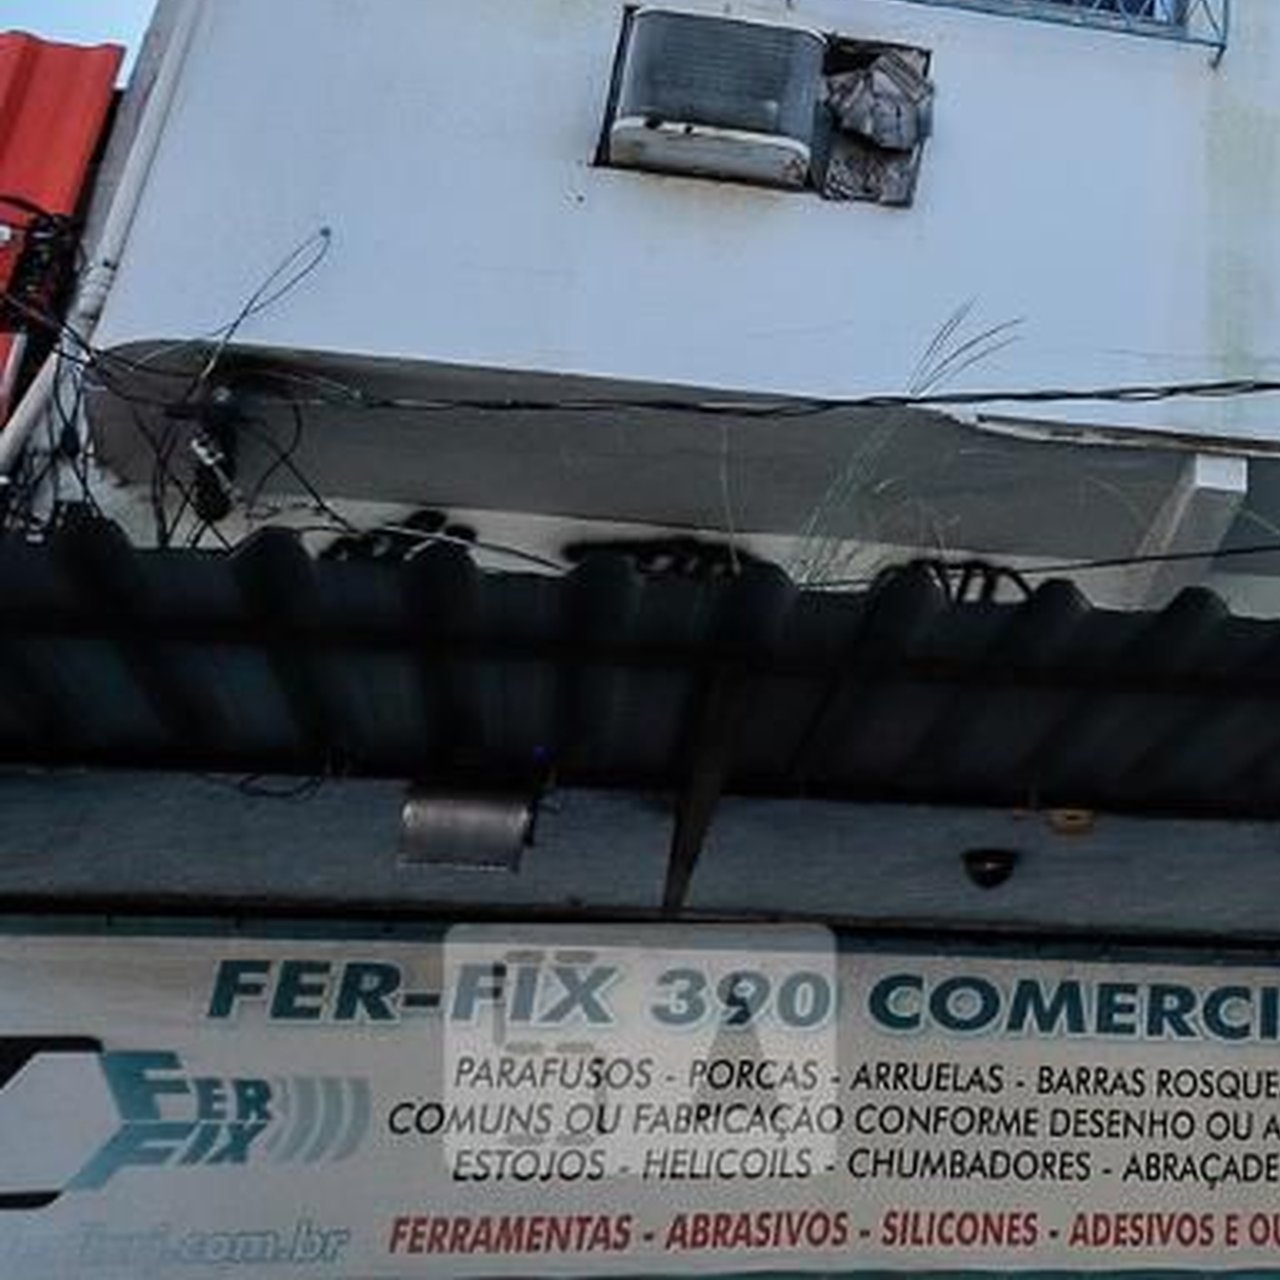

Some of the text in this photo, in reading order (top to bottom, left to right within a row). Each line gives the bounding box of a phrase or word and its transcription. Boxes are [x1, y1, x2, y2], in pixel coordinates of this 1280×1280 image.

[206, 957, 630, 1028] FER-FIX
[648, 967, 838, 1031] 390
[454, 1056, 653, 1093] PARAFUSOS
[689, 1057, 820, 1093] PORCAS
[850, 1059, 1003, 1095] ARRUELAS
[1036, 1064, 1147, 1097] BARRAS
[388, 1101, 554, 1137] COMUNS
[564, 1101, 624, 1137] OU
[853, 1105, 1041, 1138] CONFORME
[1048, 1107, 1198, 1141] DESENHO
[1204, 1109, 1256, 1141] OU
[451, 1147, 606, 1183] ESTOJOS
[642, 1146, 812, 1181] HELICOILS
[847, 1150, 1092, 1183] CHUMBADORES
[389, 1214, 633, 1254] FERRAMENTAS
[665, 1212, 850, 1250] ABRASIVOS
[881, 1211, 1039, 1249] SILICONES
[1068, 1213, 1220, 1248] ADESIVOS
[1225, 1213, 1238, 1246] E
